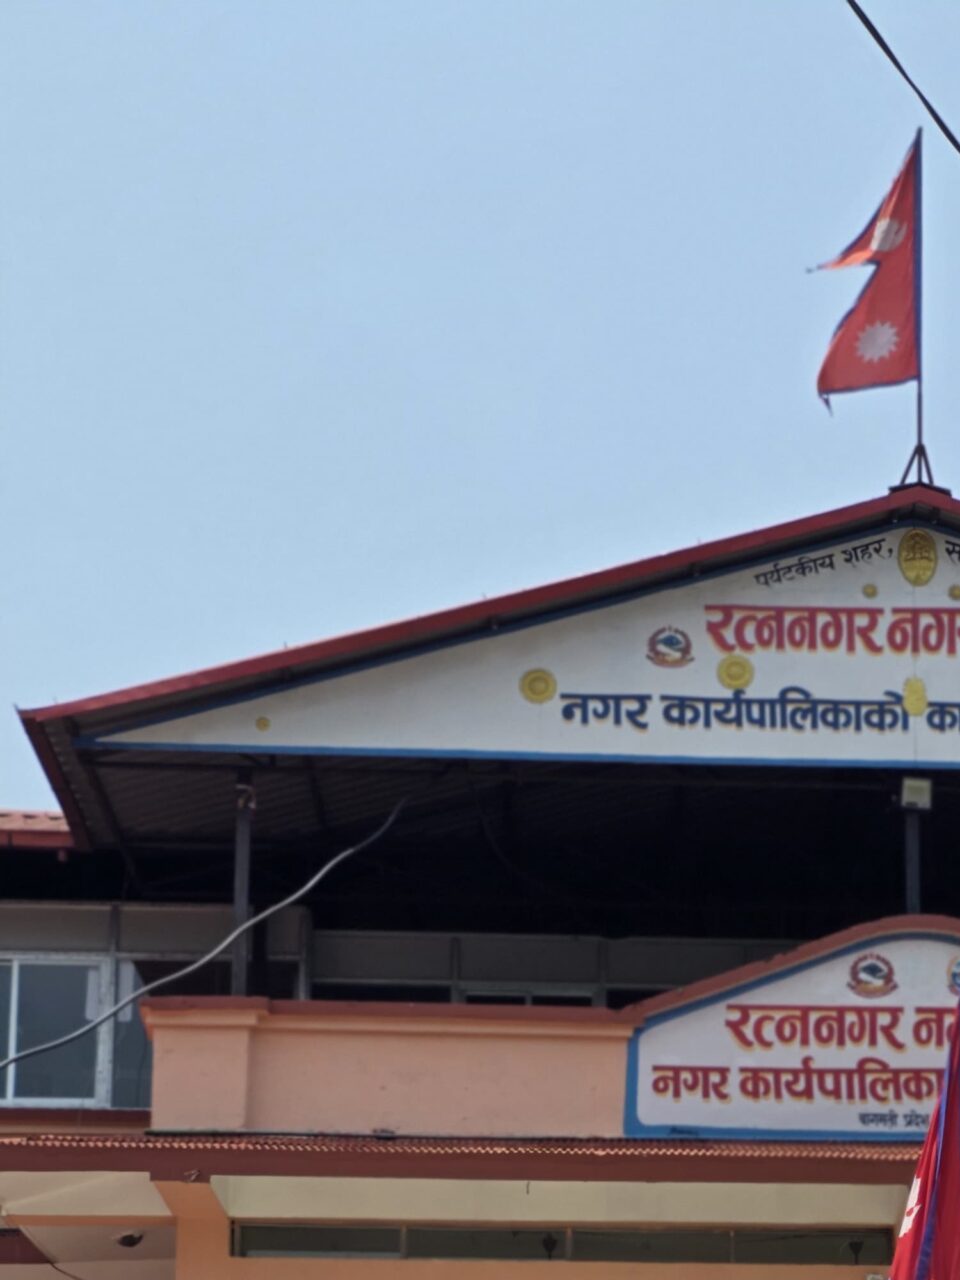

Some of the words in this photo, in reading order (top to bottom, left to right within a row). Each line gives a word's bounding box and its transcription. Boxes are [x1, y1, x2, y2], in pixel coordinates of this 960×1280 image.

[754, 550, 835, 587] पर्यटकीय
[705, 604, 884, 655] रत्ननगर
[560, 693, 652, 729] नगर
[660, 686, 908, 732] कार्यपालिकाको
[724, 1003, 906, 1051] रत्ननगर
[652, 1064, 731, 1102] नगर
